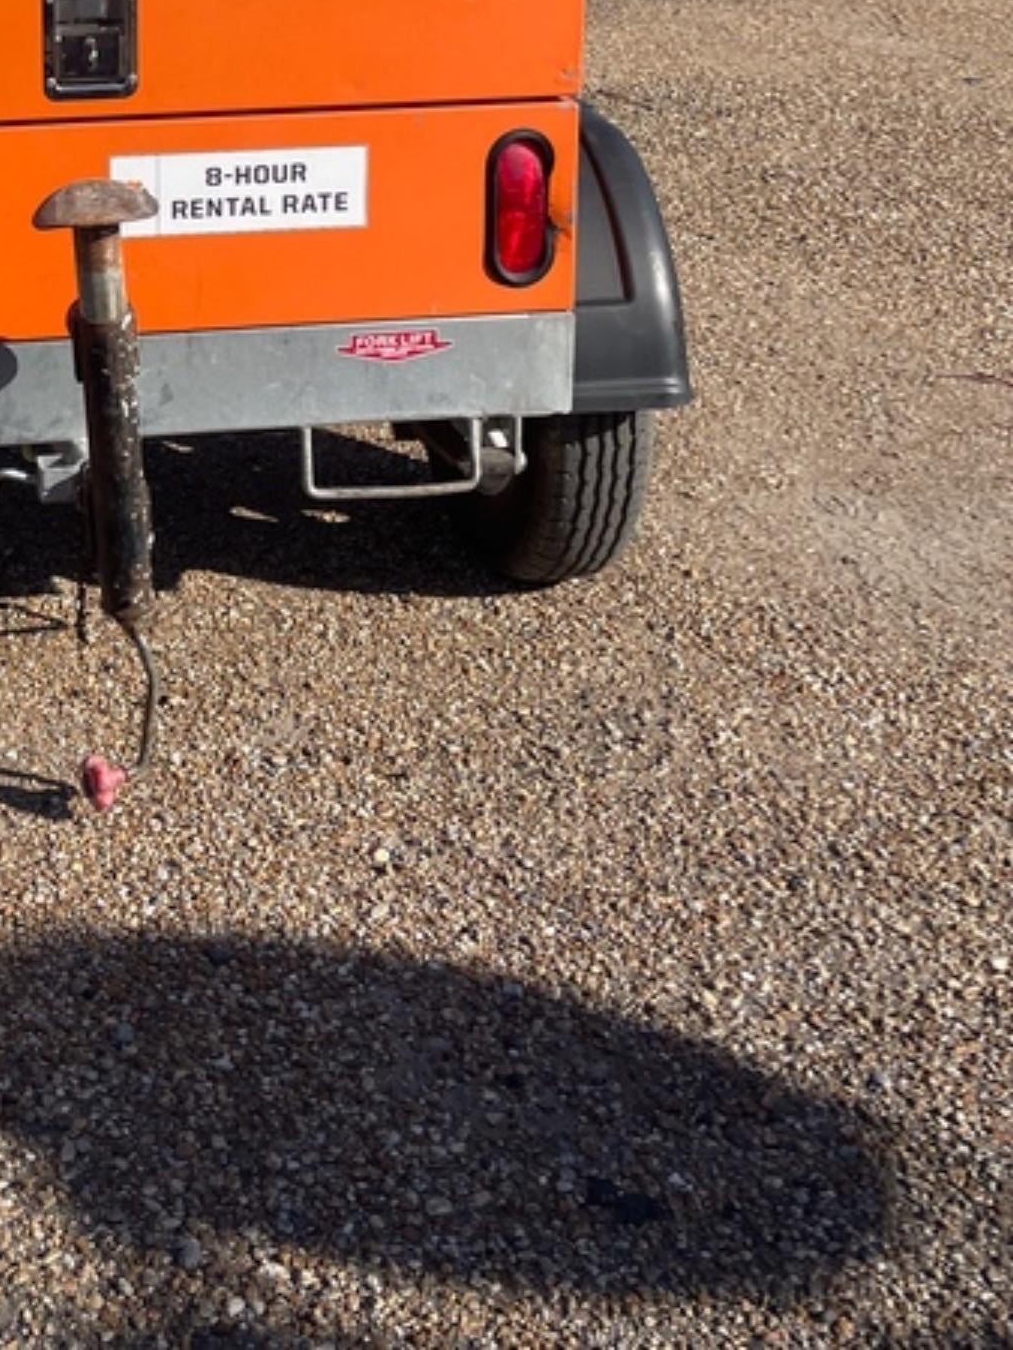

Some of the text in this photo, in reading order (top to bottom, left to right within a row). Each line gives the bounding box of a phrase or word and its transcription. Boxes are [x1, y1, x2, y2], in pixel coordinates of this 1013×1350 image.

[204, 162, 307, 187] 8-HOUR
[171, 191, 349, 220] RENTAL RATE
